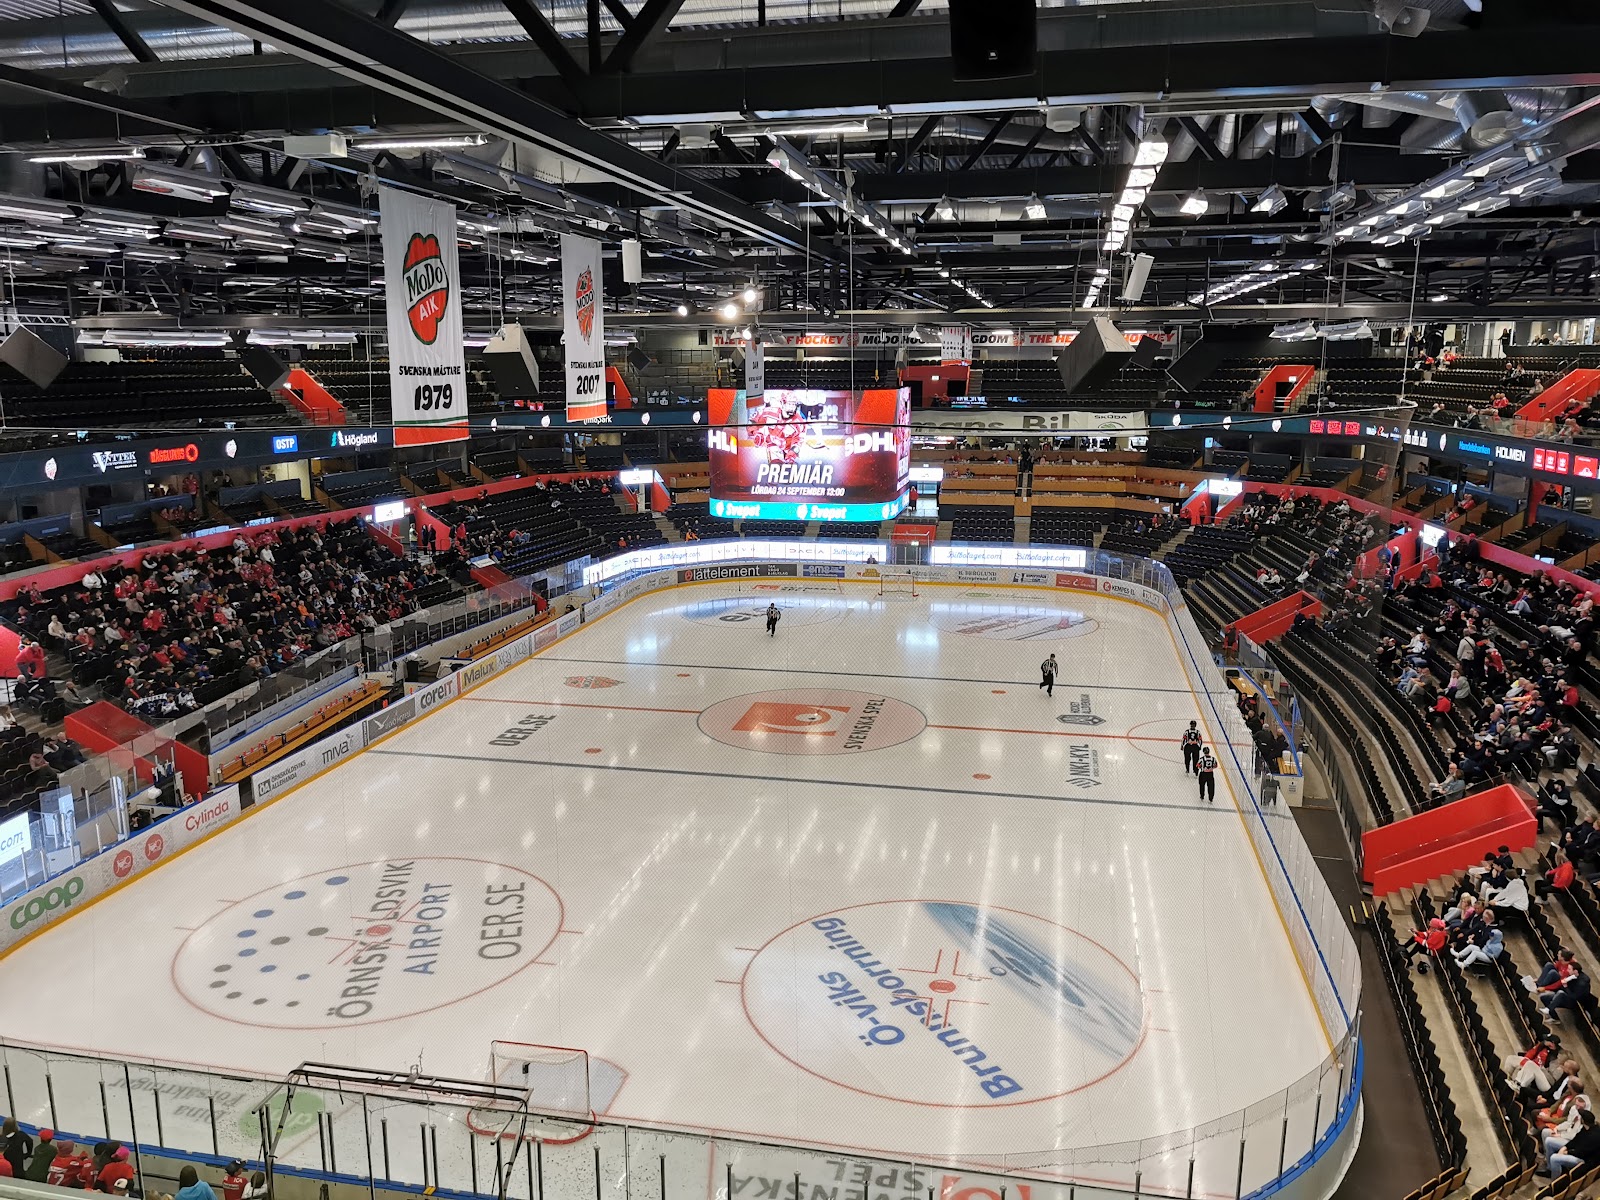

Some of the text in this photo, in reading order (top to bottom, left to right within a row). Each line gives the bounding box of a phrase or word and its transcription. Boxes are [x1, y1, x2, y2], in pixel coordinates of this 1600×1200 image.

[406, 262, 443, 303] MoDo
[419, 296, 439, 322] AIK
[795, 335, 844, 345] HOCKEY
[1029, 334, 1054, 344] THE
[399, 365, 431, 377] SVENSKA
[414, 384, 453, 411] 1979
[576, 375, 600, 395] 2007
[276, 438, 295, 450] OSTP
[344, 432, 378, 446] Högland
[1495, 446, 1526, 462] HOLMEN
[757, 461, 834, 485] PREMIÄR
[751, 485, 777, 495] LÖRDAG
[777, 486, 786, 495] 24
[786, 486, 825, 496] SEPTEMBER
[693, 565, 760, 580] lättelement
[463, 660, 495, 687] Malux
[488, 713, 557, 747] OER.SE
[843, 696, 886, 749] SVENSKA SPEL
[185, 800, 229, 831] Cylinda
[10, 876, 84, 930] coop
[402, 882, 453, 975] AIRPORT
[478, 881, 526, 960] OER.SE
[811, 917, 1024, 1099] Brunnsborrning
[818, 970, 906, 1047] Ö-viks
[826, 1159, 926, 1192] SPEL
